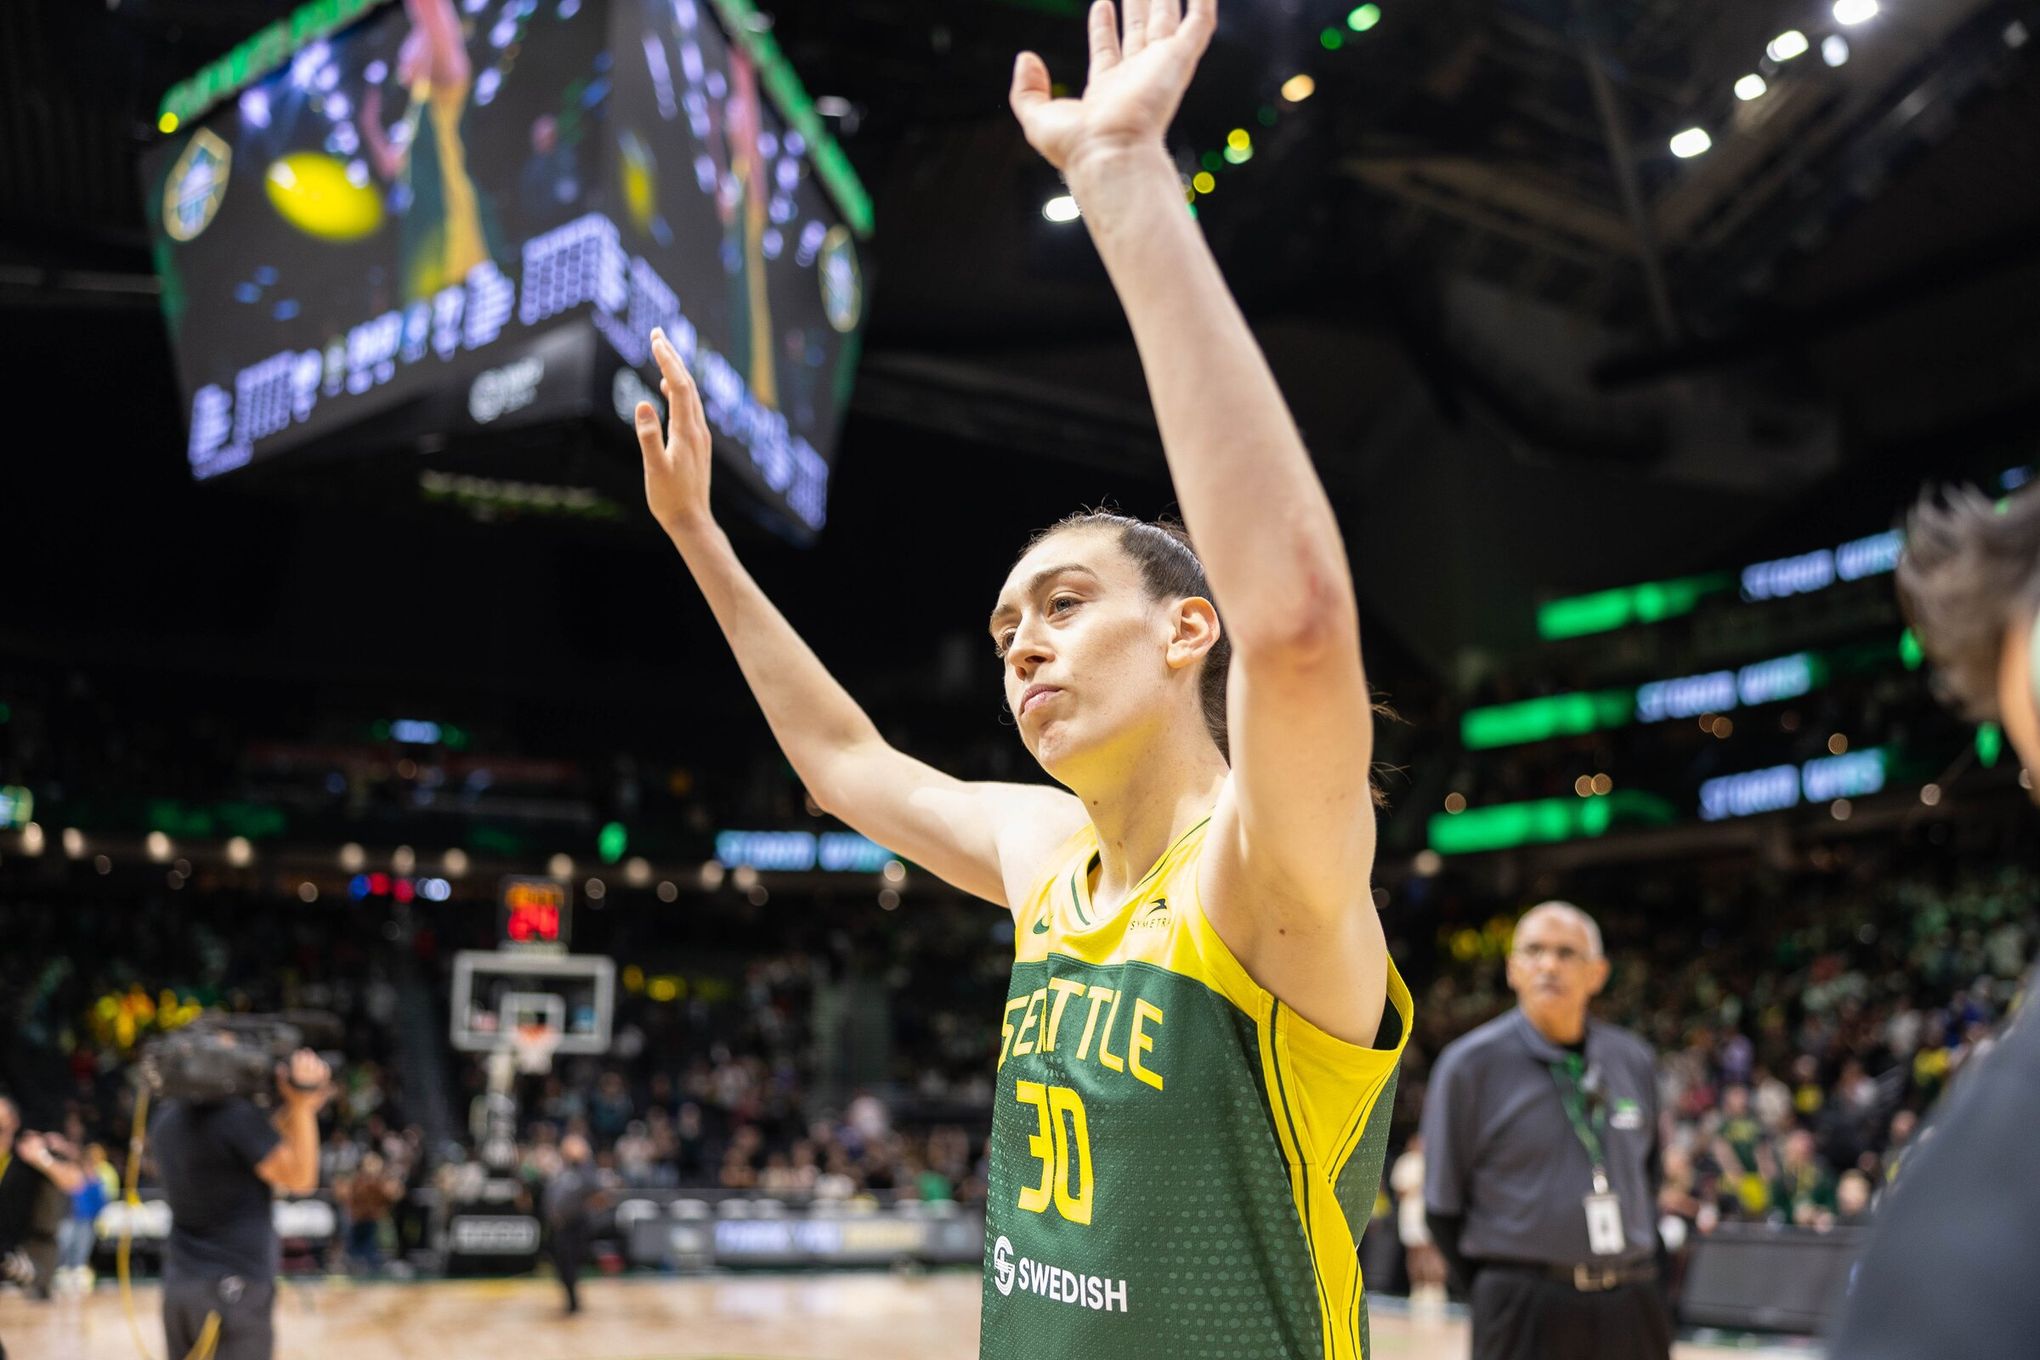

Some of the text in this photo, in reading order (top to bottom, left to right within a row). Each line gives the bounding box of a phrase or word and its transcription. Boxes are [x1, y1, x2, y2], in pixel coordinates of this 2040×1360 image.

[997, 977, 1164, 1091] SEATTLE
[1016, 1080, 1094, 1226] 30
[1018, 1257, 1128, 1313] SWEDISH
